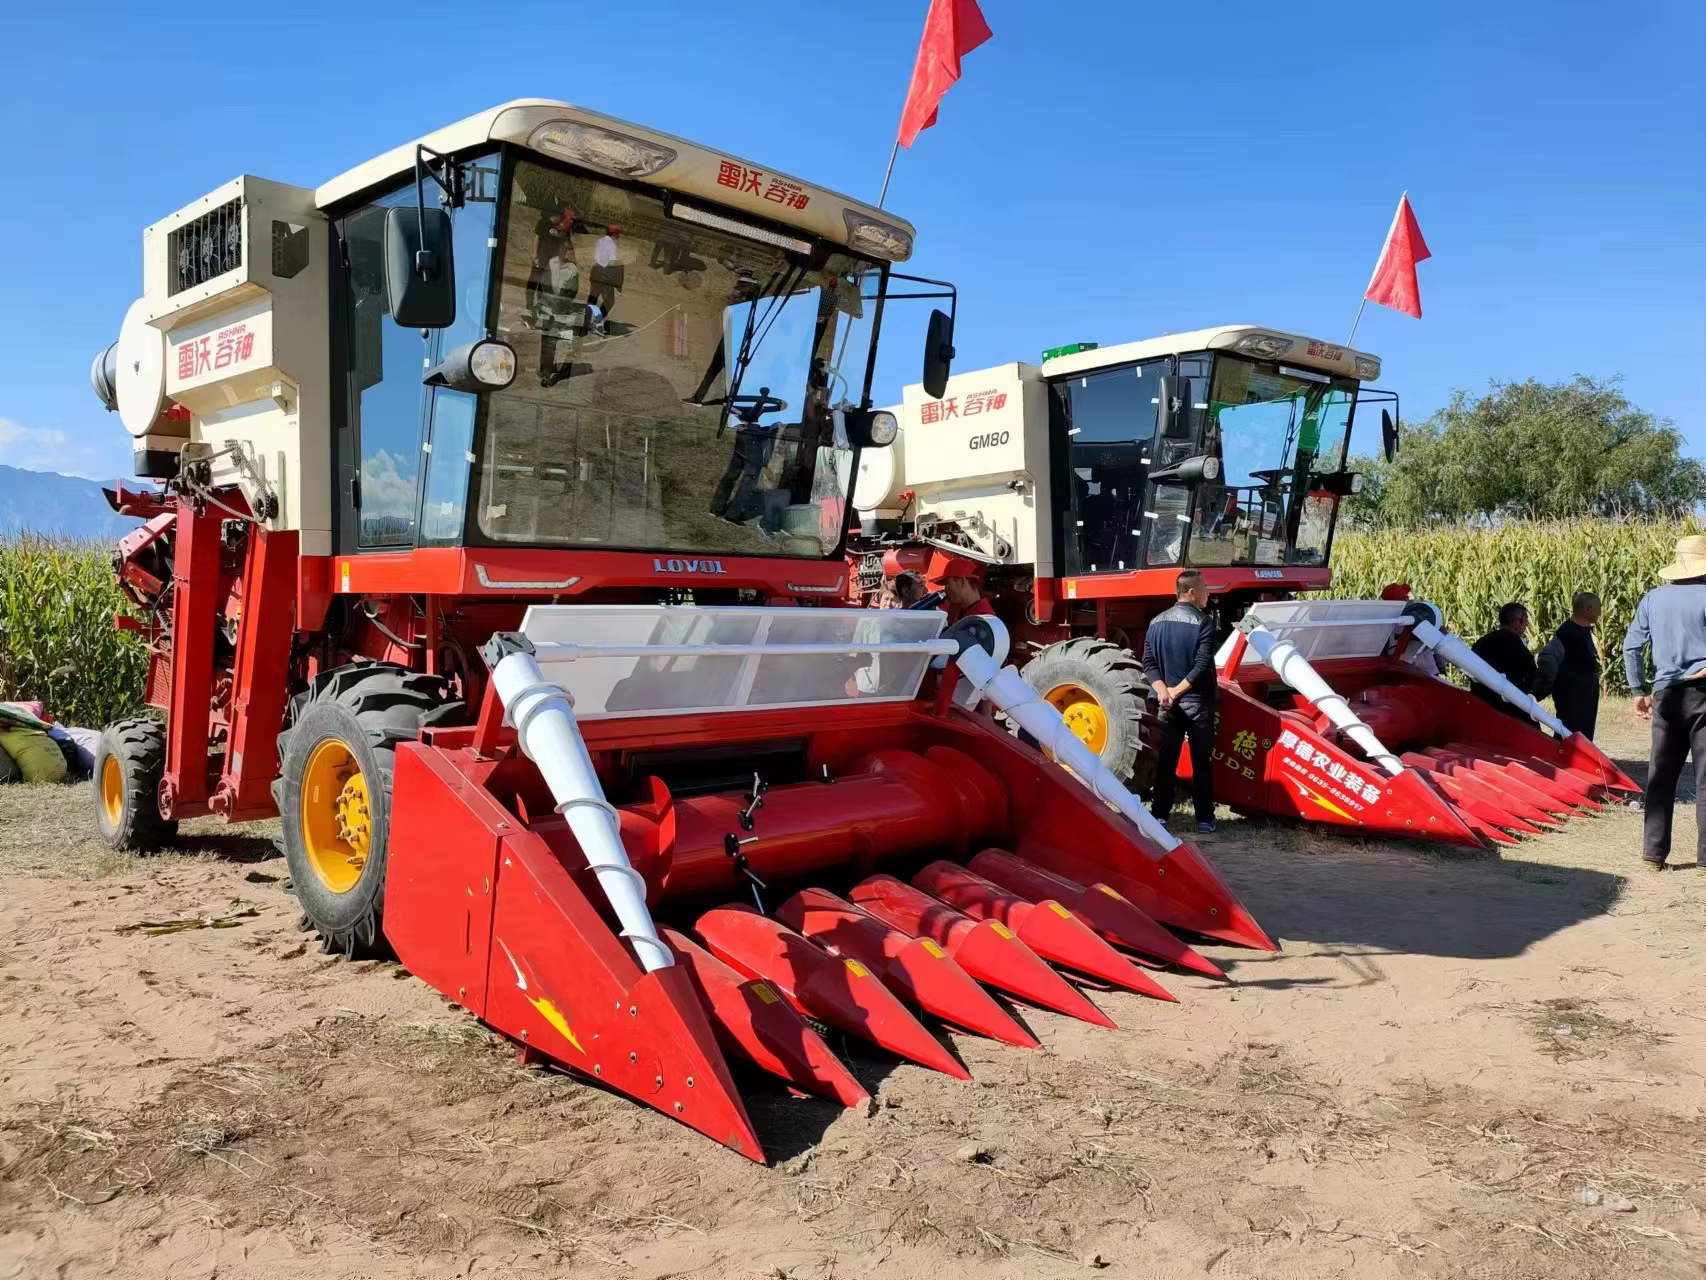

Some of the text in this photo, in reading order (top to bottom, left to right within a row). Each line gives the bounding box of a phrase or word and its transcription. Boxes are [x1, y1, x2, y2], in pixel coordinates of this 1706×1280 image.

[717, 160, 810, 209] 雷沃谷神
[178, 333, 254, 380] 雷沃谷神
[921, 393, 1007, 425] 雷沃谷神
[969, 430, 1010, 450] GM80
[653, 559, 728, 574] LOVOL
[1209, 747, 1255, 780] UDE
[1277, 729, 1381, 805] 厚德农业装备
